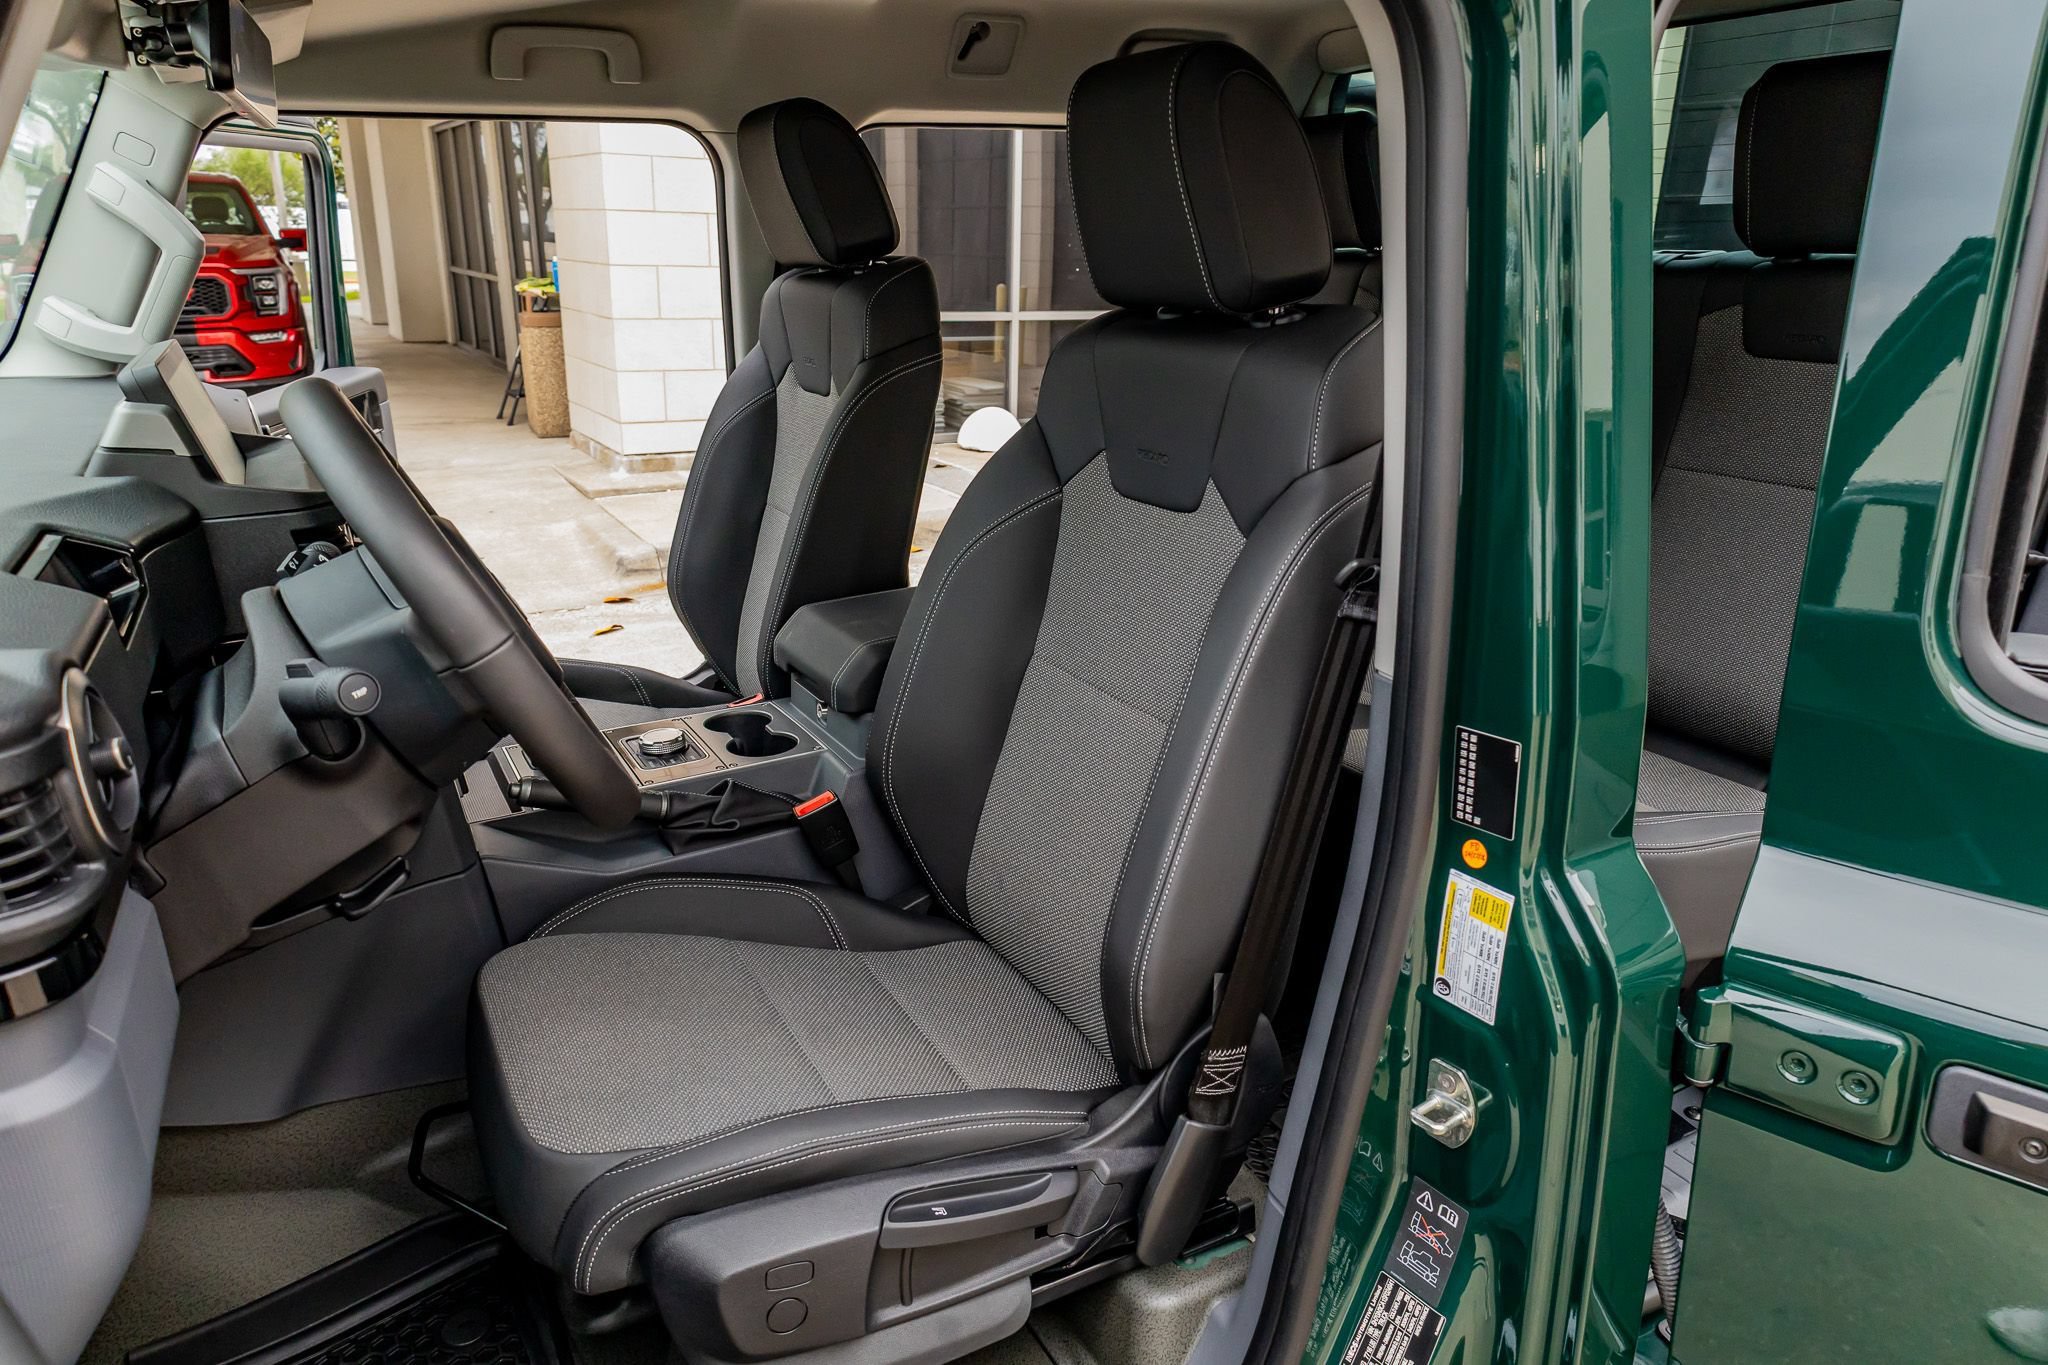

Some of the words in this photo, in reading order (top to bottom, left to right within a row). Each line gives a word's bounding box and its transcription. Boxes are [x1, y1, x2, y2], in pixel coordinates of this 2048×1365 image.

[351, 686, 368, 700] TRIP
[1345, 1340, 1358, 1362] INEOS
[1355, 1307, 1373, 1341] AUTOMOTIVE
[1370, 1285, 1382, 1306] Limited
